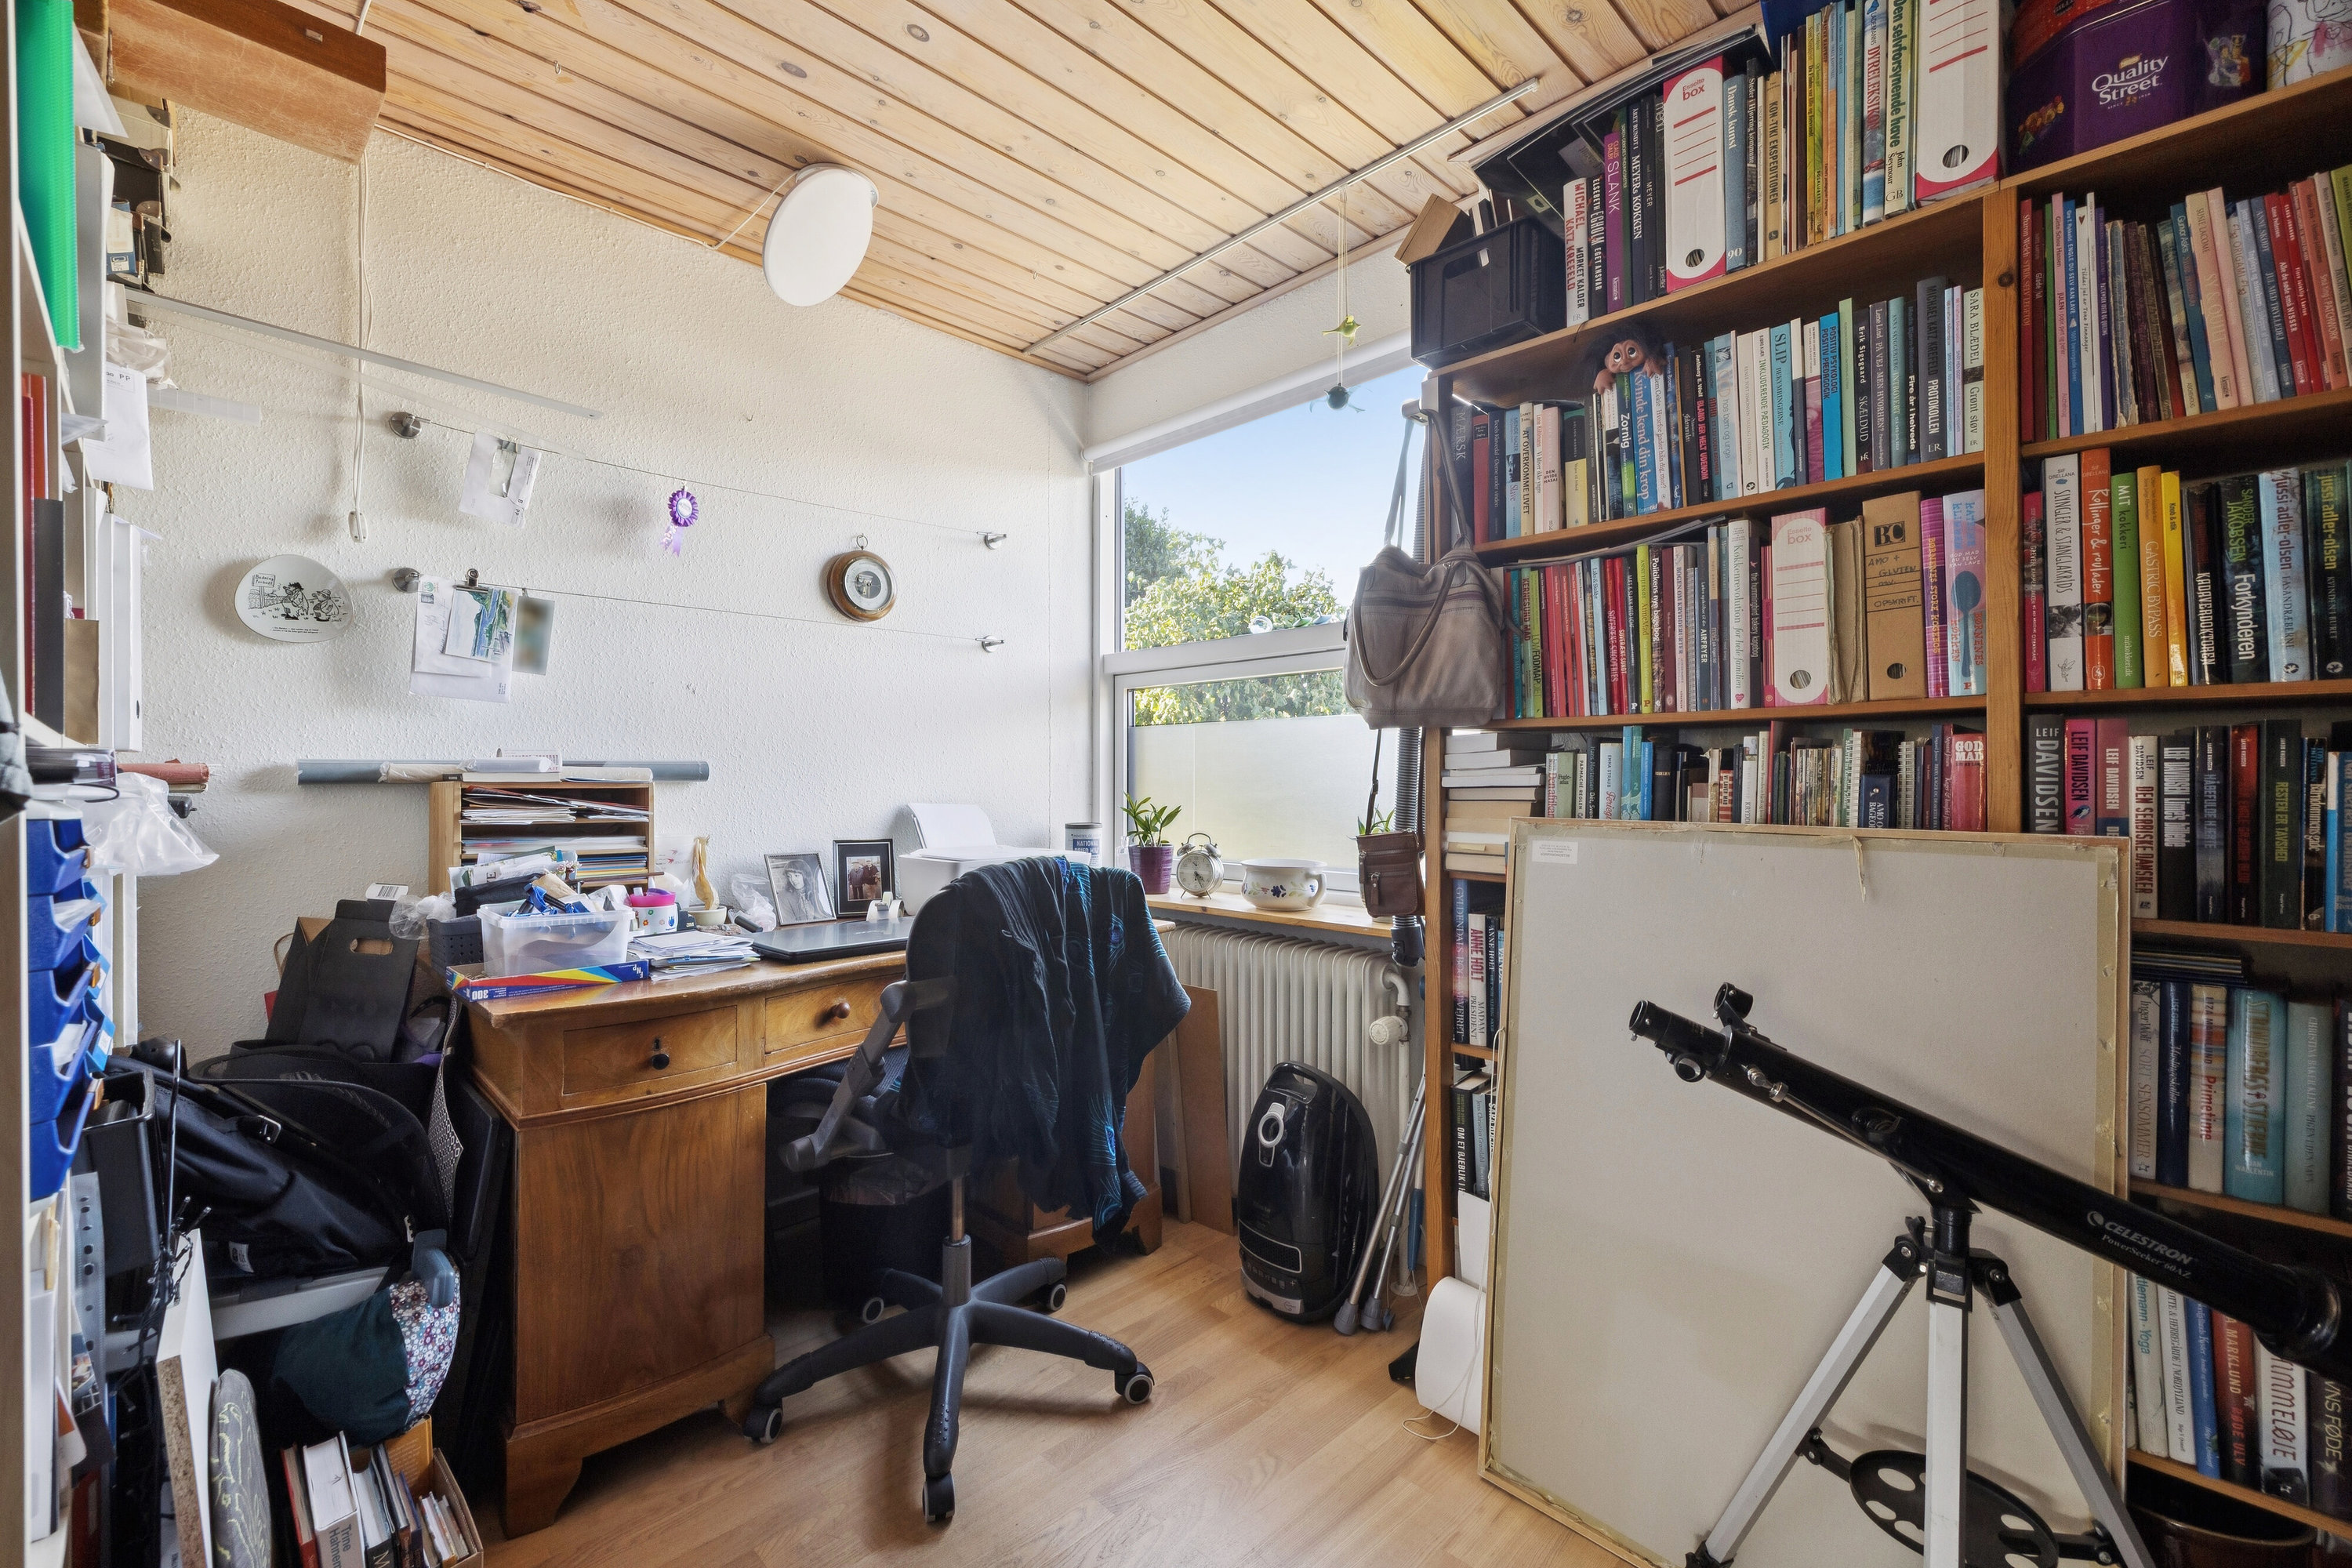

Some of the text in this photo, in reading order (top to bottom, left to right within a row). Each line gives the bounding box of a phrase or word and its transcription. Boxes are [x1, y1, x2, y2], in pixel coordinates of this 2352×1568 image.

[1681, 77, 1706, 93] Esselte
[1681, 85, 1706, 100] box
[1866, 44, 1880, 130] DYRELEKSIKON
[1888, 0, 1908, 149] Den selvforsynende have
[2092, 56, 2170, 93] Quality
[2100, 74, 2161, 105] Street
[1726, 85, 1737, 151] Dansk kunst
[1769, 100, 1780, 205] KON-TIKI EKSPEDITIONEN
[1885, 152, 1897, 185] Seymour
[1894, 151, 1905, 168] John
[1574, 182, 1585, 229] MICHAEL
[1607, 160, 1620, 213] SLANK
[1645, 180, 1654, 207] MEYER
[1590, 177, 1604, 292] ELSEBETH EGHOLM EGET ANSVAR
[1632, 194, 1642, 240] KØKKEN
[1565, 220, 1576, 292] KATZ KREFELD
[1728, 248, 1744, 259] 90
[1576, 278, 1585, 309] KALDER
[1875, 342, 1885, 351] PÅ
[1969, 292, 1979, 364] SARA BLÆDEL
[1693, 354, 1703, 378] Anthony
[1773, 332, 1788, 426] SLIP BEKYMRINGERNE
[1822, 358, 1831, 400] PÆDAGOGIK
[1828, 326, 1839, 394] POSITIV PSYKOLOGI
[1858, 345, 1867, 384] Sigsgaard
[1926, 284, 1940, 434] MICHAEL KATZ KREFELD PROTOKOLLEN
[1697, 400, 1706, 422] BLAND
[1758, 358, 1770, 450] INKLUDERENDE PÆDAGOGIK
[1858, 395, 1869, 442] SKÆLDUD
[1875, 390, 1885, 431] HVORHEN?
[1908, 395, 1918, 406] år
[1969, 386, 1980, 433] Grønt støv
[1523, 430, 1530, 441] AT
[1620, 412, 1631, 448] Zornig
[1632, 370, 1651, 500] Kvinde kend din krop
[1698, 436, 1708, 452] HELT
[1700, 452, 1709, 480] UDENOM
[2048, 470, 2076, 480] ORELLANA
[1508, 485, 1519, 502] Slave
[2054, 489, 2071, 527] SLYNGLER
[2241, 489, 2255, 525] SANDER
[2272, 477, 2291, 503] jussi
[1788, 525, 1813, 535] Esselte
[1788, 533, 1813, 544] box
[2117, 485, 2132, 550] MIT kokkeri
[2227, 500, 2247, 563] JAKOBSEN
[2275, 506, 2294, 571] adler-olsen
[2318, 474, 2341, 571] jussi adler-olsen
[1867, 557, 1889, 566] AMO
[2082, 488, 2111, 594] Rollinger & roulader
[1651, 557, 1661, 594] Politikens
[1878, 564, 1916, 577] GLUTEN
[2054, 536, 2076, 594] STANGLAKRIDS
[1927, 536, 1941, 654] BØRNENES STORE KOGEBOG
[2145, 541, 2162, 638] GASTRIC BYPASS
[1523, 624, 1532, 641] MAD
[1640, 602, 1650, 637] AnneMad
[1651, 610, 1661, 641] bagebog
[1733, 544, 1745, 688] Køkkenrevolution for hele familien
[2195, 572, 2216, 665] KADAVERDOKTOREN
[2231, 572, 2258, 660] Forkynderen
[1700, 627, 1709, 663] AIRFRYER
[1951, 618, 1962, 662] KØKKEN
[1973, 613, 1984, 666] BØRNENES
[2123, 633, 2132, 677] mitkokkeri.dk
[1955, 740, 1984, 753] GOD
[2035, 728, 2060, 737] LEIF
[1955, 751, 1984, 762] MAD
[2071, 731, 2089, 801] LEIF DAVIDSEN
[2134, 745, 2145, 779] DAVIDSEN
[2145, 754, 2154, 771] LEIF
[2035, 739, 2059, 833] DAVIDSEN
[2106, 748, 2120, 809] LEIF DAVIDSEN
[2164, 746, 2190, 848] LEIF DAVIDSEN Limes billede
[2134, 786, 2154, 894] DEN SERBISKE DANSKER
[2274, 781, 2289, 862] RESTEN ER TAVSHED
[1469, 928, 1485, 983] ANNE HOLT
[470, 989, 489, 1000] 300
[2136, 999, 2153, 1157] Inger Wolf SORT SENSOMMER
[2198, 1074, 2217, 1140] Primetime
[1457, 1127, 1466, 1182] OM ET ØJEBLIK
[2101, 1234, 2162, 1265] PowerSeeker
[2104, 1221, 2194, 1265] CELESTRON
[2136, 1330, 2153, 1355] Yoga
[2324, 1414, 2343, 1461] FØDE
[342, 1524, 351, 1552] Trine
